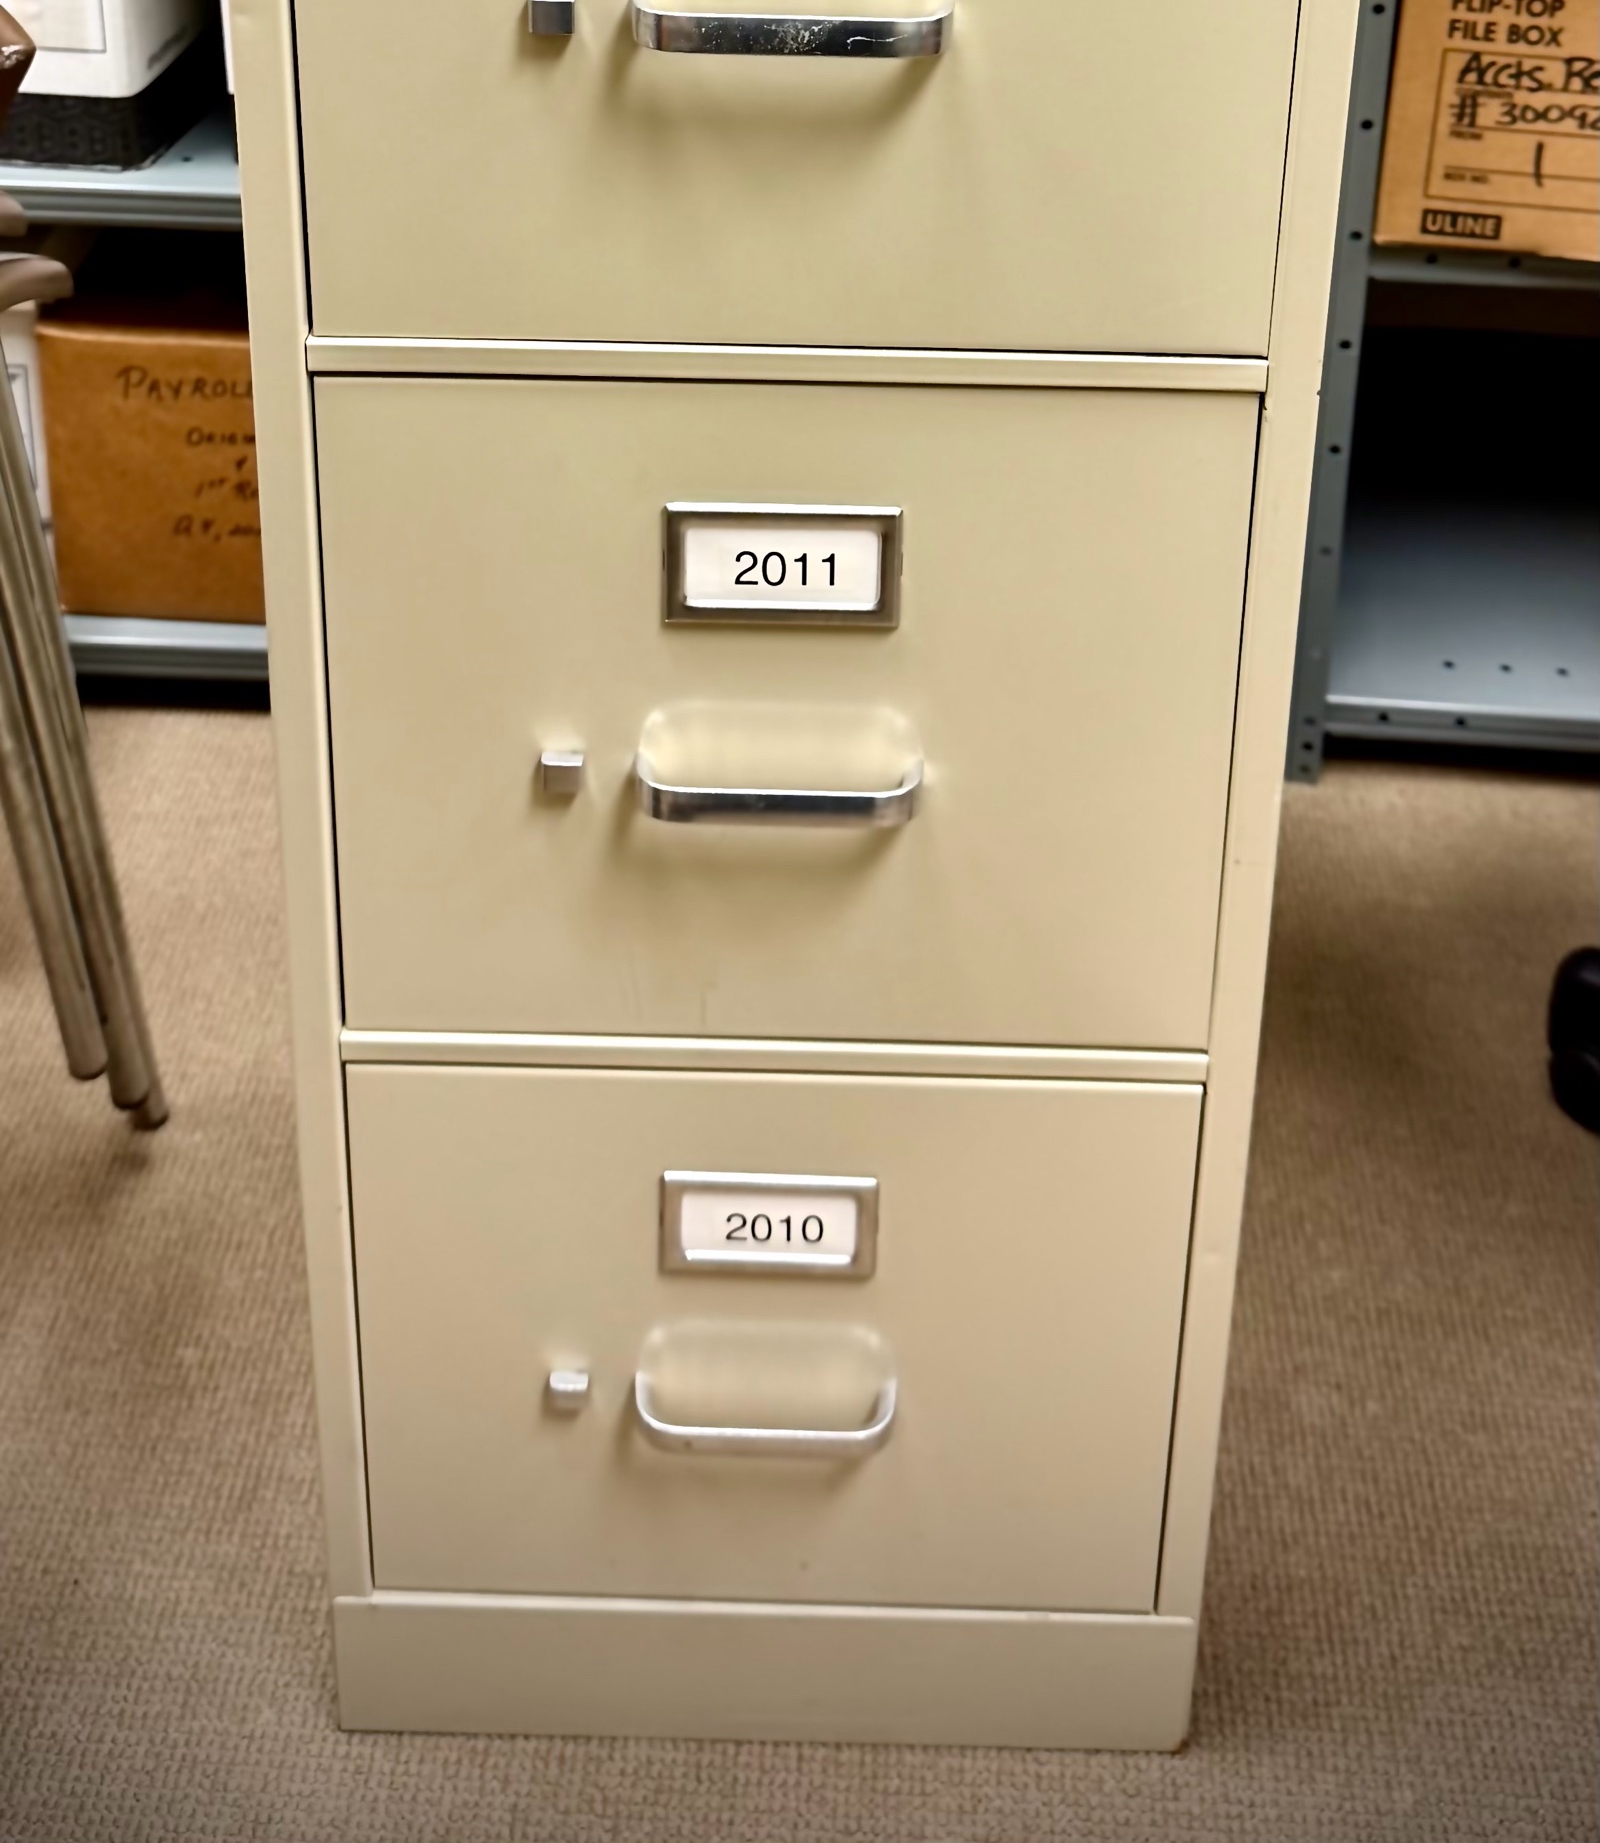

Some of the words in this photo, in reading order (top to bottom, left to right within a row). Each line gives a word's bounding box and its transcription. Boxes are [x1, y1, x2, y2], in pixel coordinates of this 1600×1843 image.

[1448, 19, 1497, 42] FILE
[1507, 23, 1564, 47] BOX
[1426, 212, 1498, 237] ULINE
[734, 550, 836, 587] 2011
[725, 1212, 824, 1243] 2010
